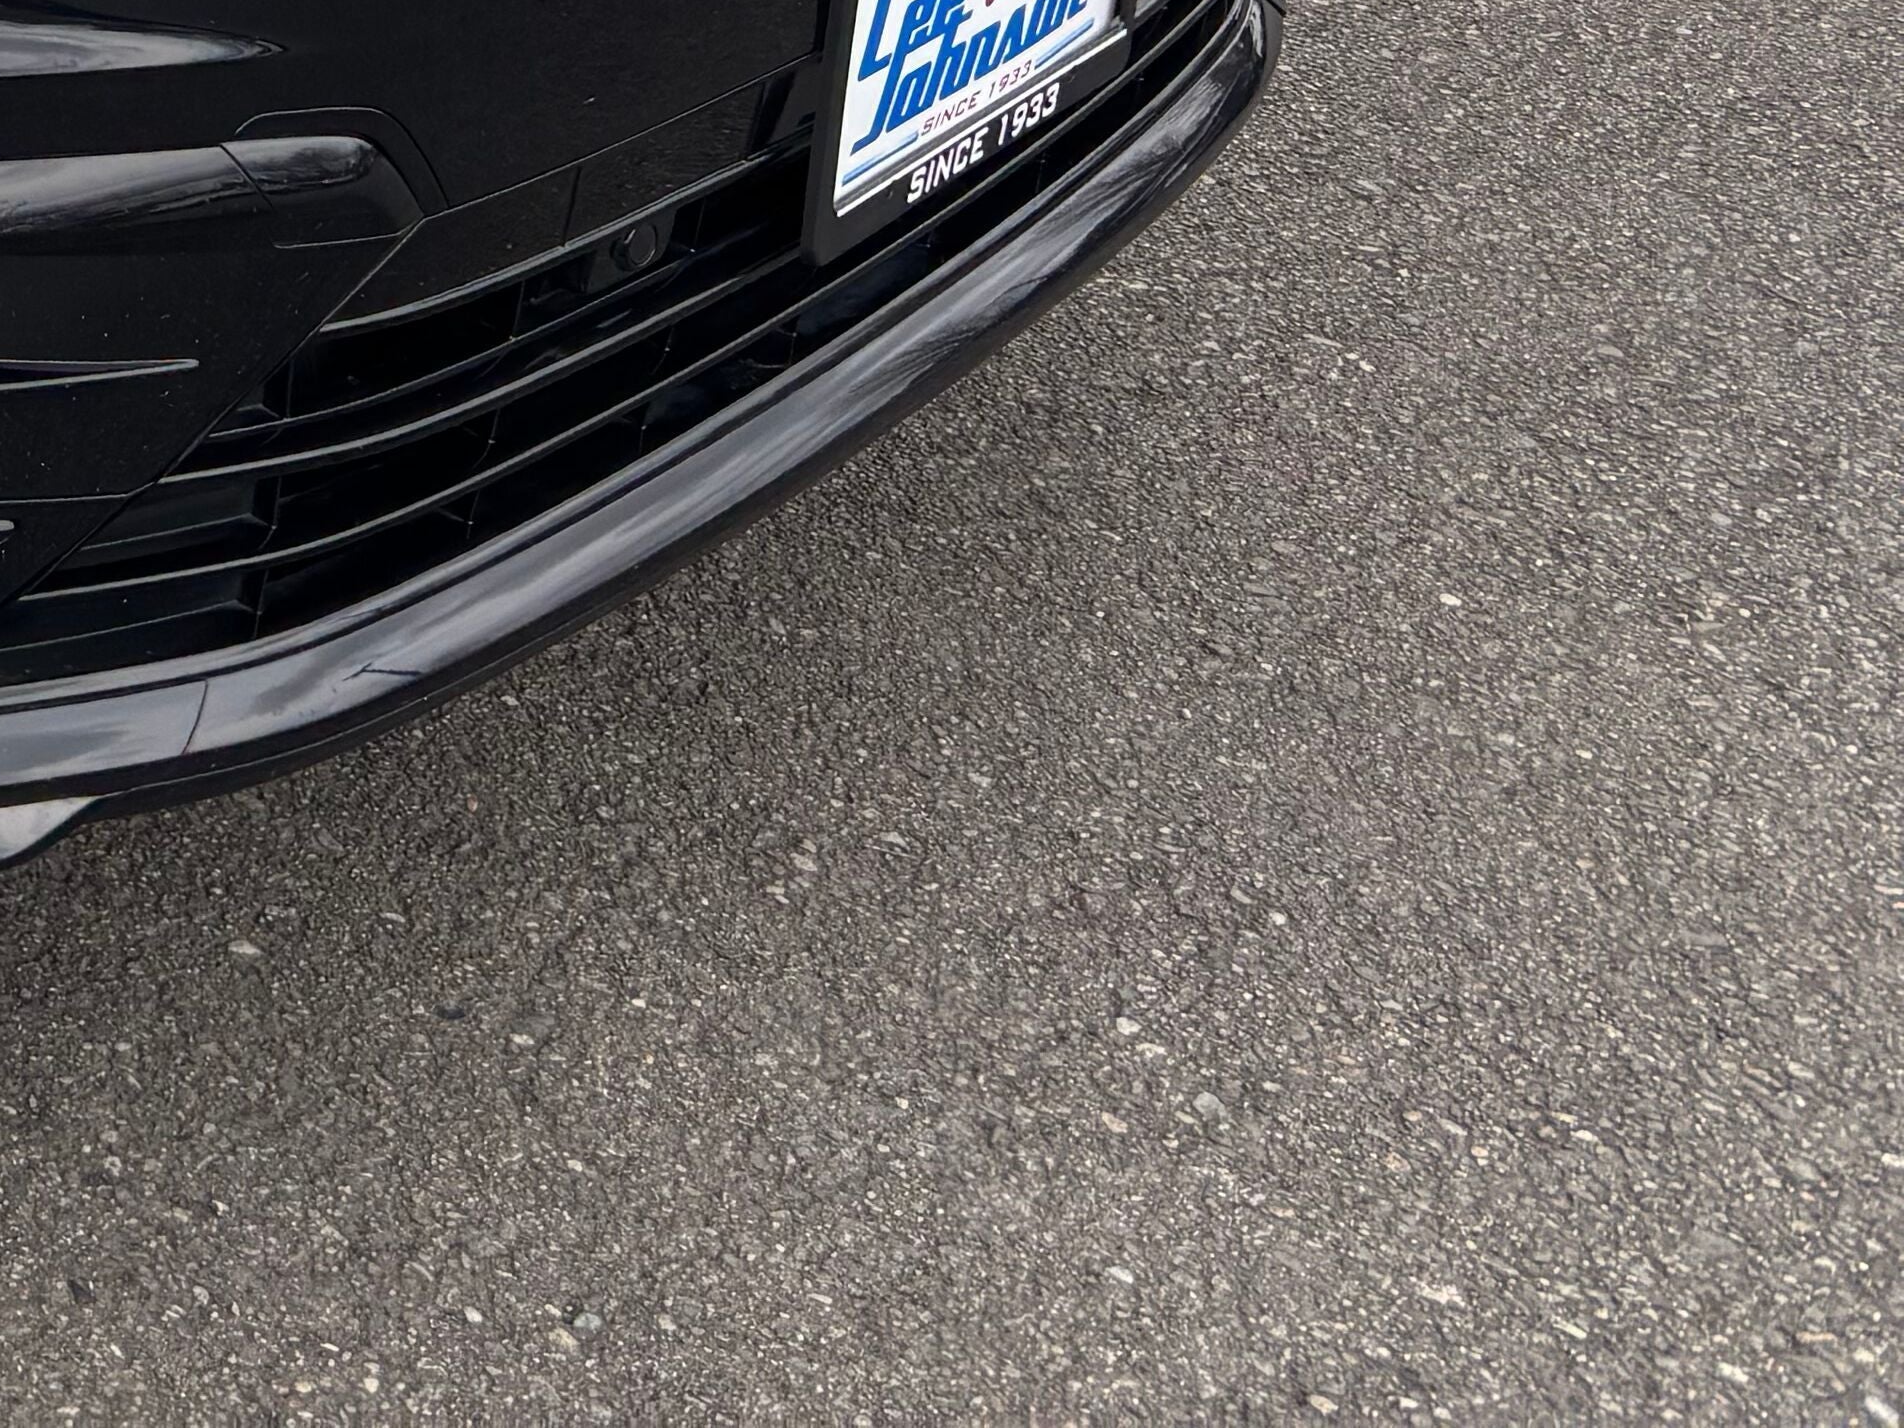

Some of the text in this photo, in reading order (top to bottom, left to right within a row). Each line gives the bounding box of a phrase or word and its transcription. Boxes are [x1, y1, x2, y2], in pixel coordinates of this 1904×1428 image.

[906, 81, 1060, 204] SINCE 1933
[920, 59, 1032, 137] SINCE 1933
